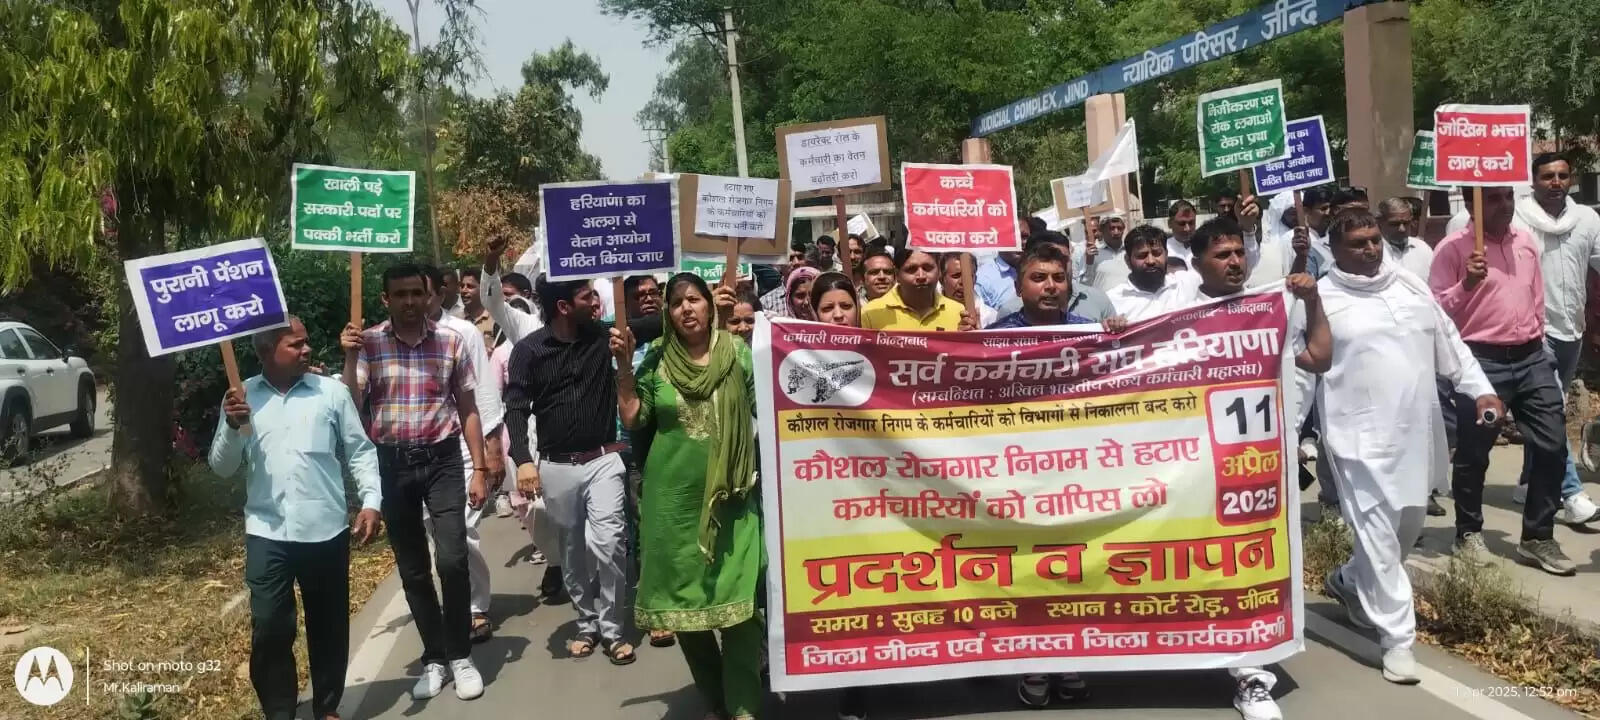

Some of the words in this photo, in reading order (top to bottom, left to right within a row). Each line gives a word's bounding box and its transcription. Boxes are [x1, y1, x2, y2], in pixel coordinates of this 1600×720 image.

[1121, 48, 1175, 83] न्यायिक
[1181, 25, 1248, 64] परिसर,
[1260, 0, 1318, 40] जीन्द
[979, 109, 1011, 134] JUDICIAL
[1014, 91, 1062, 121] COMPLEX,
[1065, 79, 1089, 104] JIND
[1208, 100, 1259, 117] निजीकरण
[1261, 95, 1274, 106] पर
[1210, 119, 1231, 134] रोक
[1234, 110, 1273, 130] लगाओ
[1438, 117, 1487, 138] जोखिम
[1491, 123, 1526, 137] भत्ता
[1220, 135, 1243, 149] ठेका
[1247, 131, 1268, 145] प्रथा
[1296, 129, 1309, 138] का
[1215, 150, 1253, 168] समाप्त
[1255, 142, 1276, 158] करो
[1295, 141, 1305, 152] से
[799, 153, 831, 168] कर्मचारी
[833, 153, 845, 163] का
[847, 150, 866, 160] वेतन
[1288, 155, 1314, 168] आयोग
[1447, 156, 1483, 177] लागू
[1481, 150, 1514, 170] करो
[324, 176, 360, 191] खाली
[841, 169, 858, 181] करो
[939, 172, 974, 189] कच्चे
[1261, 174, 1282, 186] गठित
[1284, 171, 1305, 182] किया
[1305, 168, 1323, 178] जाए
[303, 201, 354, 216] सरकारी
[357, 203, 383, 217] पदों
[385, 208, 402, 218] पर
[570, 193, 622, 210] हरियाणा
[627, 195, 646, 206] का
[912, 198, 985, 217] कर्मचारियों
[987, 200, 1007, 217] को
[582, 215, 620, 228] अलग
[624, 212, 637, 226] से
[303, 226, 342, 241] पक्की
[345, 228, 373, 243] भर्ती
[376, 229, 401, 244] करो
[570, 234, 603, 248] वेतन
[606, 230, 651, 246] आयोग
[924, 231, 966, 245] पक्का
[969, 227, 999, 245] करो
[560, 253, 596, 268] गठित
[600, 250, 633, 265] किया
[636, 251, 664, 262] जाए
[704, 265, 723, 278] भर्ती
[150, 265, 210, 304] पुरानी
[213, 260, 264, 282] पेंशन
[172, 308, 228, 332] लागू
[223, 294, 264, 320] करो
[1228, 302, 1273, 315] जिन्दाबाद
[783, 330, 826, 344] कर्मचारी
[830, 333, 861, 345] एकता
[876, 332, 928, 349] जिन्दाबाद
[888, 352, 949, 386] सर्व
[955, 347, 1081, 381] कर्मचारी
[911, 385, 984, 406] (सम्बन्धित
[1000, 382, 1044, 398] अखिल
[1050, 379, 1102, 396] भारतीय
[1108, 375, 1141, 389] राज्य
[1146, 365, 1202, 386] कर्मचारी
[1207, 361, 1263, 380] महासंघ)
[787, 412, 829, 433] कौशल
[832, 413, 877, 432] रोजगार
[882, 413, 912, 432] निगम
[917, 414, 929, 432] के
[931, 408, 994, 432] कर्मचारियों
[997, 409, 1016, 426] को
[1020, 404, 1065, 424] विभागों
[1068, 404, 1081, 421] से
[1084, 401, 1140, 420] निकालना
[1144, 399, 1168, 414] बन्द
[1172, 391, 1197, 410] करो
[1225, 394, 1272, 435] 11
[794, 449, 889, 481] कौशल
[895, 452, 998, 480] रोजगार
[1004, 444, 1088, 476] निगम
[1096, 438, 1124, 468] से
[1132, 438, 1200, 465] हटाए
[832, 489, 982, 520] कर्मचारियों
[986, 490, 1026, 520] को
[1034, 483, 1121, 516] वापिस
[1128, 477, 1169, 508] लो
[1222, 487, 1277, 515] 2025
[803, 533, 1017, 606] प्रदर्शन
[1032, 543, 1087, 586] व
[1103, 527, 1277, 587] ज्ञापन
[811, 614, 869, 634] समय
[891, 607, 947, 633] सुबह
[953, 606, 973, 623] 10
[979, 601, 1018, 621] बजे
[1047, 600, 1106, 618] स्थान
[1130, 595, 1180, 616] कोर्ट
[1184, 594, 1230, 618] रोड़,
[1237, 588, 1280, 610] जीन्द
[800, 645, 868, 668] जिला
[874, 639, 940, 662] जीन्द
[945, 631, 987, 657] एवं
[991, 633, 1075, 654] समस्त
[1080, 627, 1150, 649] जिला
[1156, 616, 1286, 647] कार्यकारिणी
